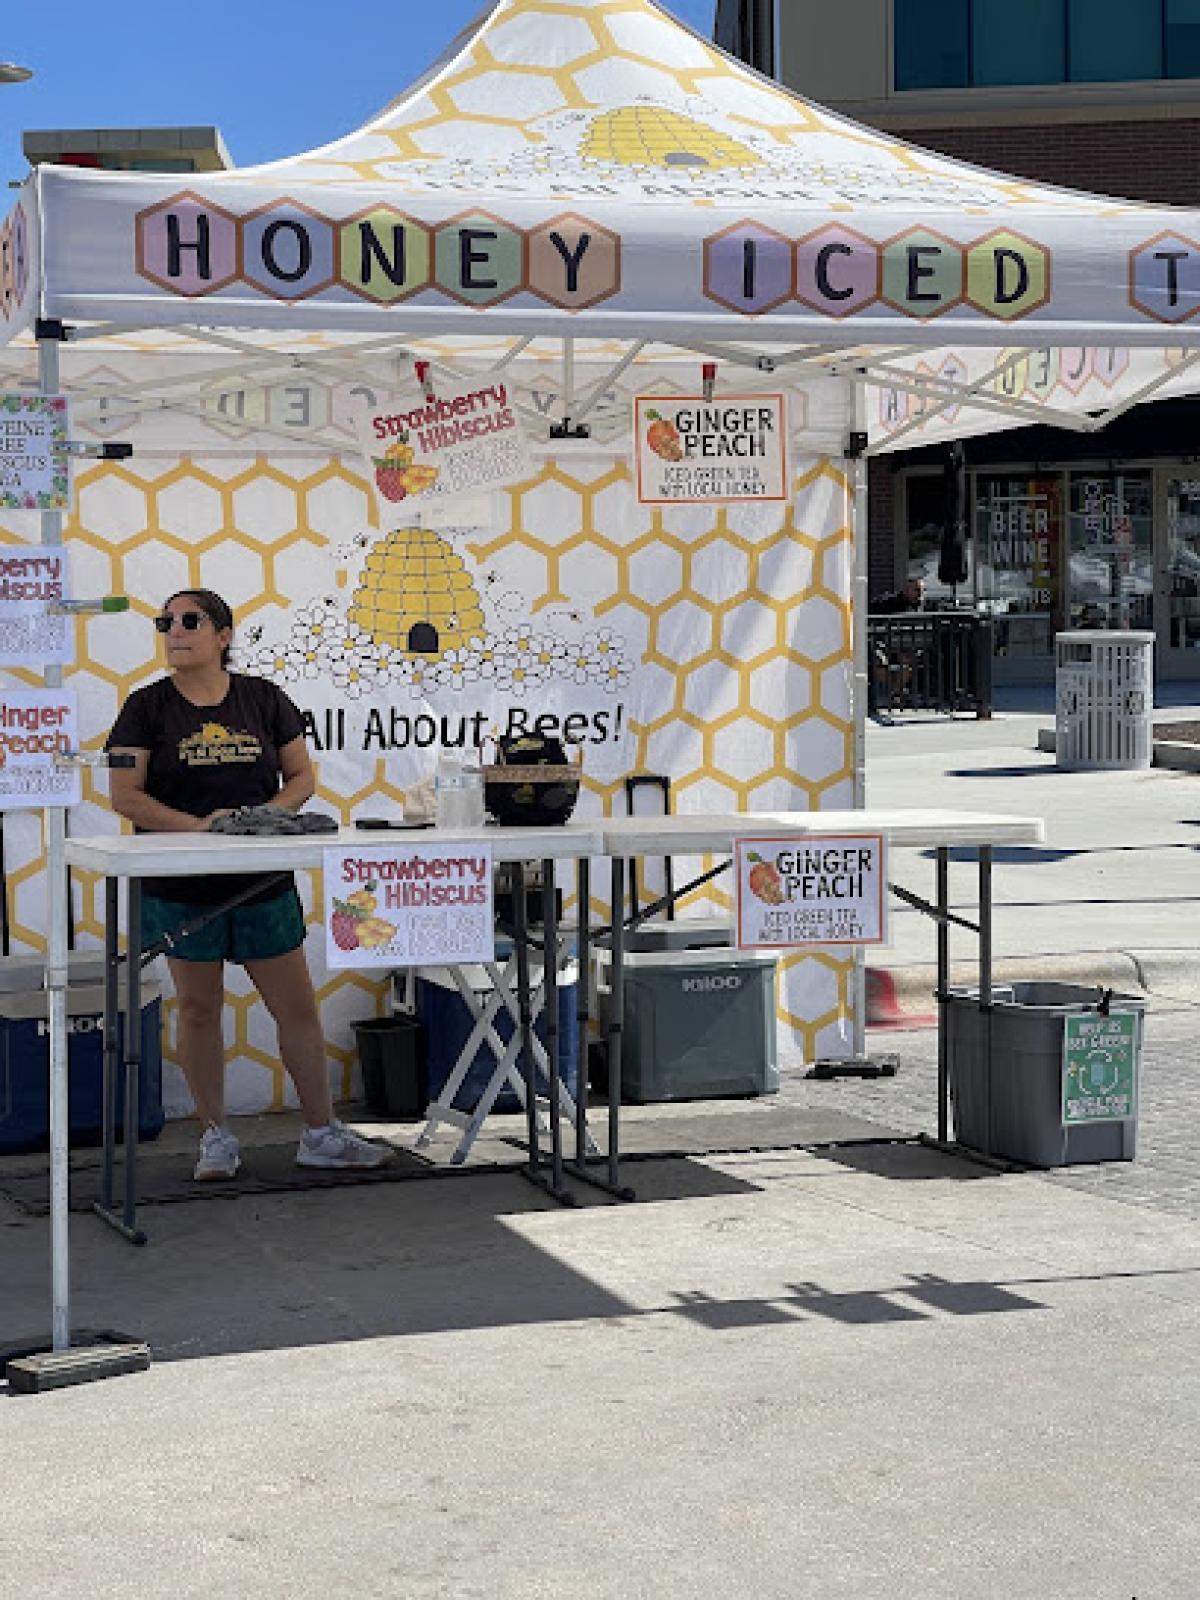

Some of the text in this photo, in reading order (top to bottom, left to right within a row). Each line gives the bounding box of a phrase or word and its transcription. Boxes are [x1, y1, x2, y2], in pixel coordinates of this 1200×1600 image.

[166, 214, 592, 292] HONEY
[743, 239, 1030, 305] ICED
[372, 383, 507, 439] Strawberry
[675, 408, 774, 433] GINGER
[417, 408, 515, 453] Hibiscus
[684, 433, 766, 457] PEACH
[300, 707, 345, 751] All
[362, 705, 488, 751] About
[507, 702, 624, 744] Bees!
[342, 856, 486, 882] Strawberry
[776, 849, 872, 874] GINGER
[385, 882, 488, 909] Hibiscus
[785, 873, 863, 900] PEACH
